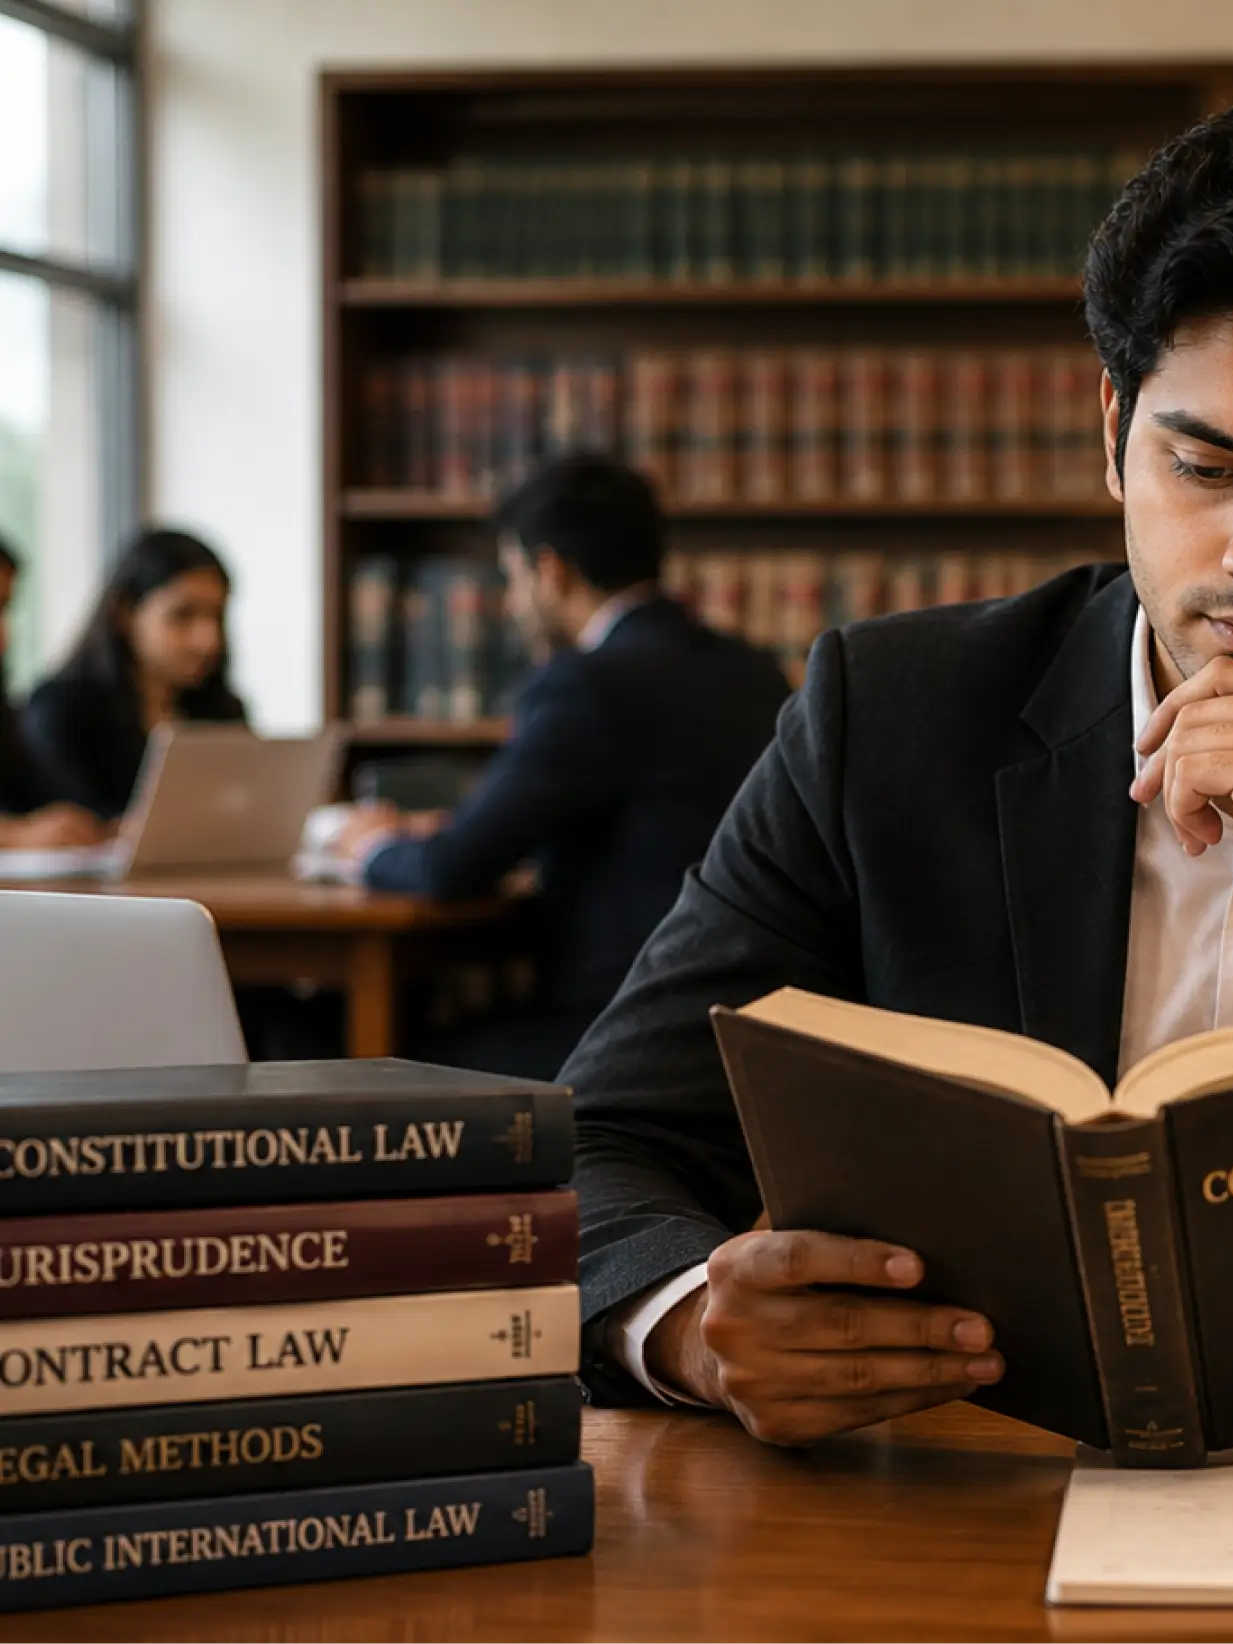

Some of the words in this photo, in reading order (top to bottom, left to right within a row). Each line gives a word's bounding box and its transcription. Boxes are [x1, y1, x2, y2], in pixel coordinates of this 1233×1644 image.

[373, 1120, 465, 1162] LAW
[0, 1229, 349, 1288] URISPRUDENCE
[0, 1335, 231, 1388] ONTRACT
[246, 1327, 350, 1371] LAW
[0, 1440, 107, 1484] EGAL
[119, 1423, 324, 1475] METHODS
[0, 1537, 93, 1581] BLIC
[103, 1511, 396, 1570] INTERNATIONAL
[405, 1503, 482, 1542] LAW
